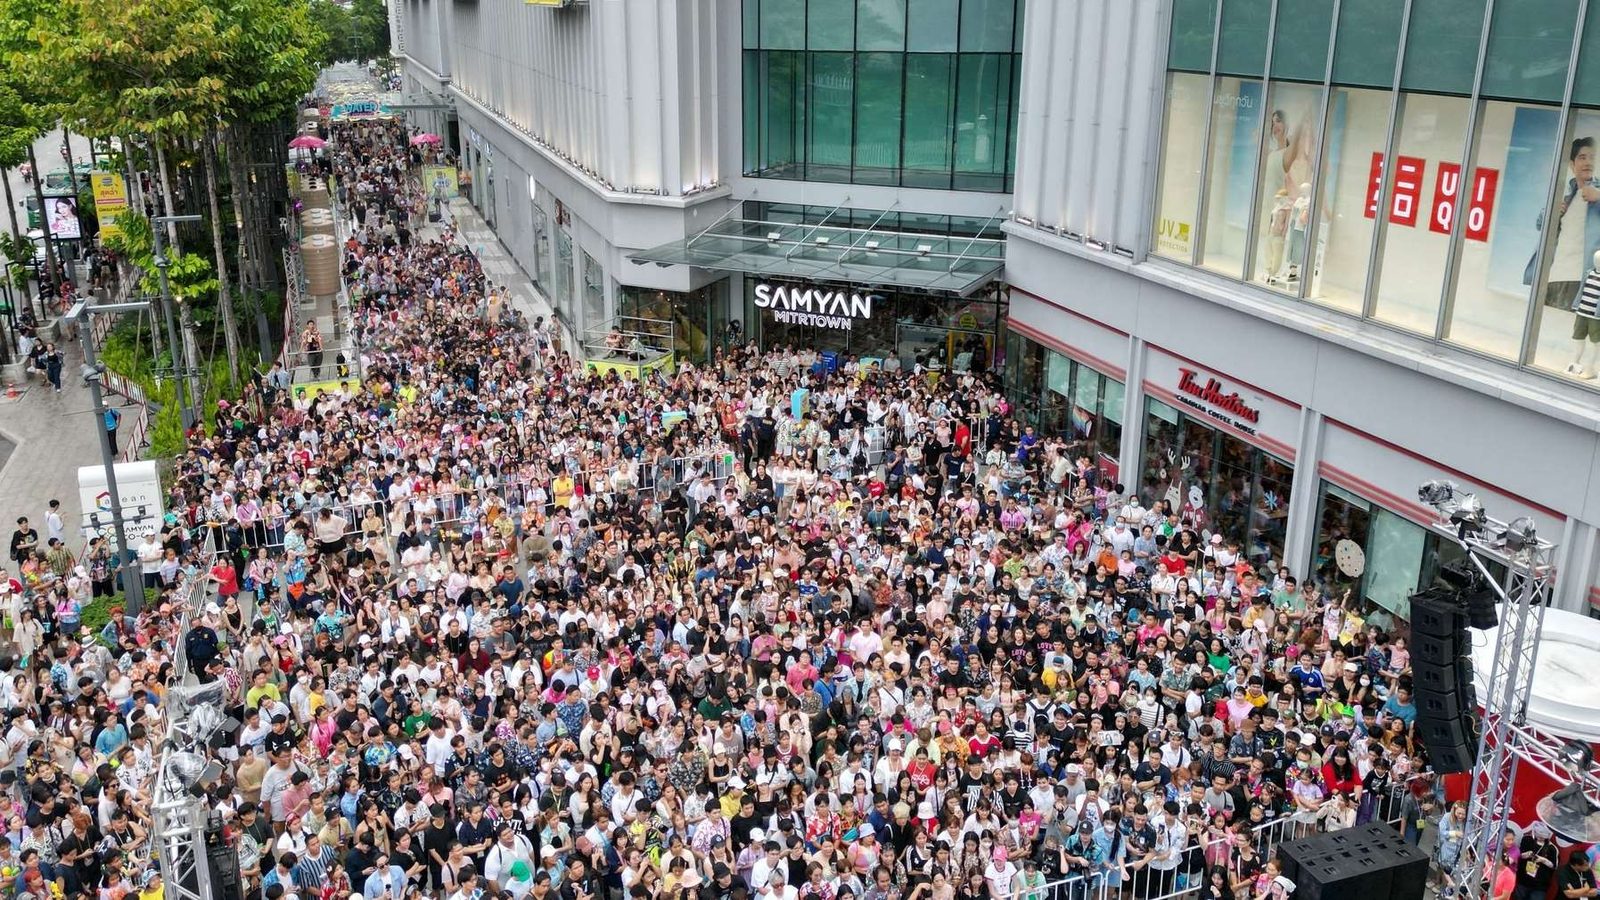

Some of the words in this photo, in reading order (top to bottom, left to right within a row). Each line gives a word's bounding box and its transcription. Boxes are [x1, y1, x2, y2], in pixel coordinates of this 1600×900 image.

[344, 101, 377, 113] WATER
[1442, 171, 1486, 202] UI
[1158, 218, 1175, 237] UV
[1436, 201, 1485, 232] QO
[754, 283, 871, 319] SAMYAN
[774, 310, 851, 330] MITRTOWN
[1178, 368, 1204, 399] Tim
[1208, 409, 1232, 425] COFFEE
[1234, 421, 1256, 436] HOUSE
[124, 524, 154, 533] AMYAN
